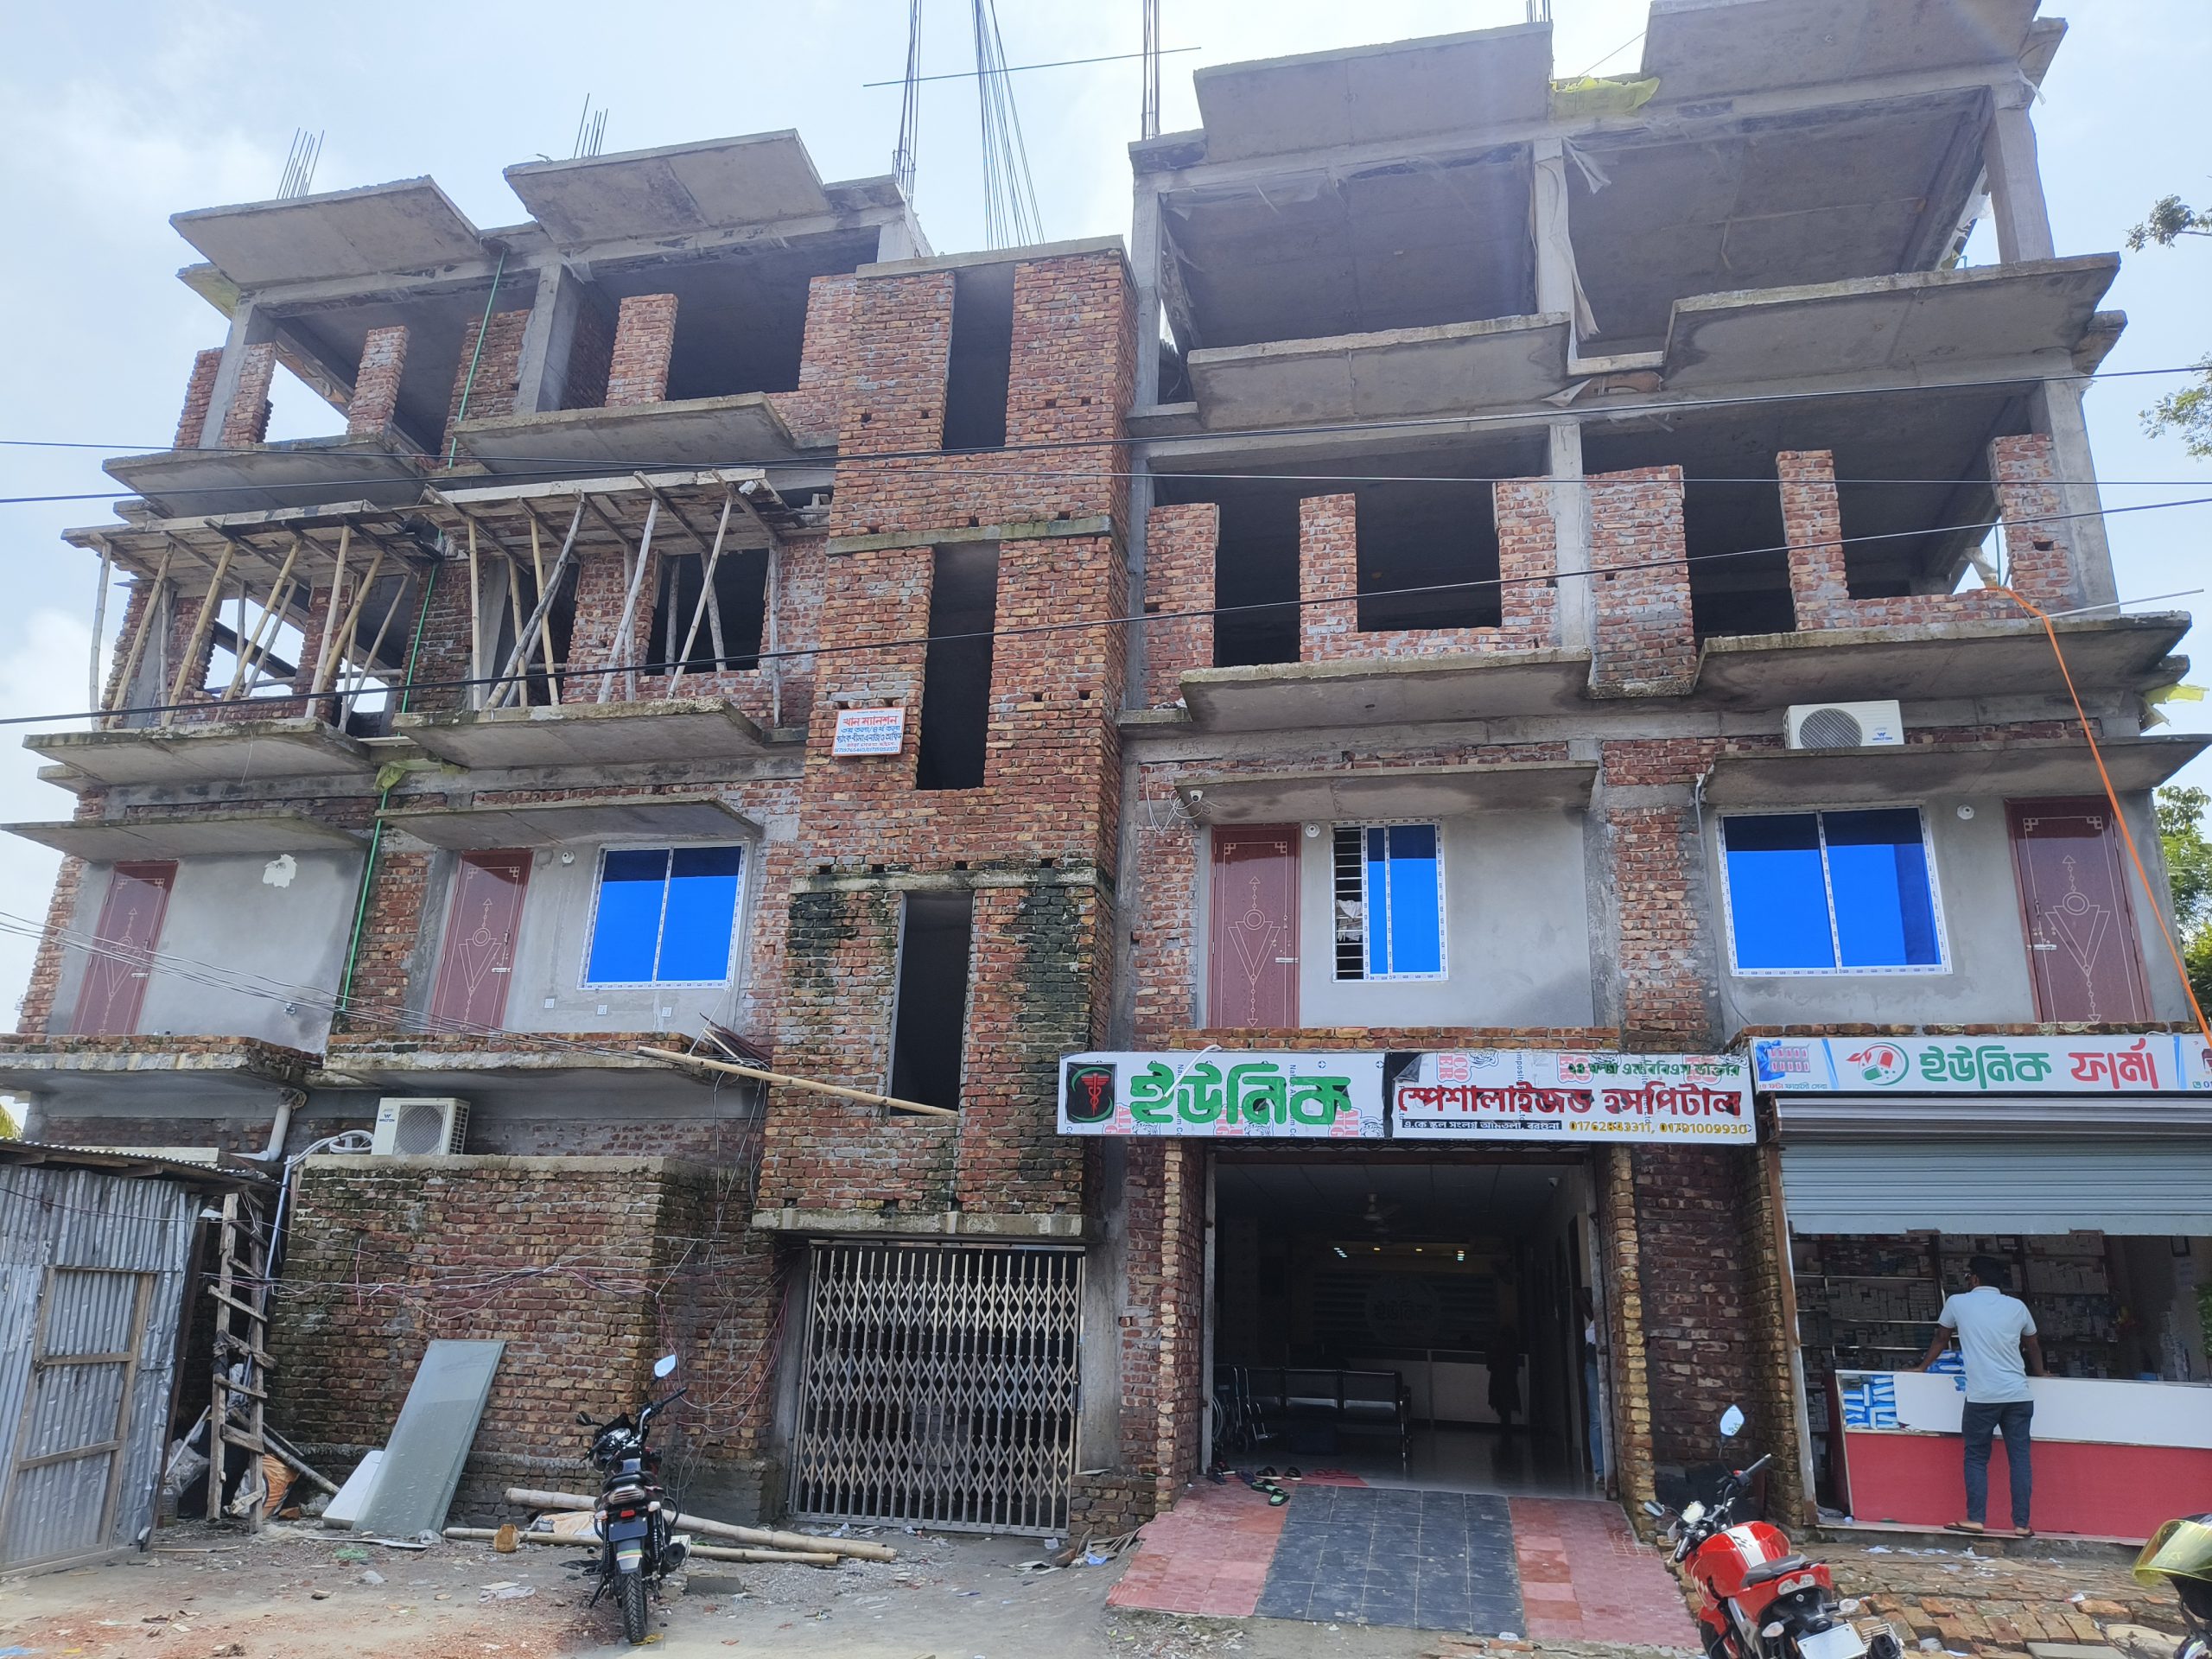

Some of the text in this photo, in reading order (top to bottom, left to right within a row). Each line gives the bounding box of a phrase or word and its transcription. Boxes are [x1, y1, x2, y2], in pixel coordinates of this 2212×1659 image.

[1695, 1062, 1740, 1077] ডাক্তার
[1919, 1037, 2159, 1090] ইউনিক ফার্মা
[1130, 1060, 1351, 1124] ইউনিক
[1398, 1081, 1594, 1115] স্পেশালাইজড
[1601, 1080, 1742, 1118] হসপিটাল
